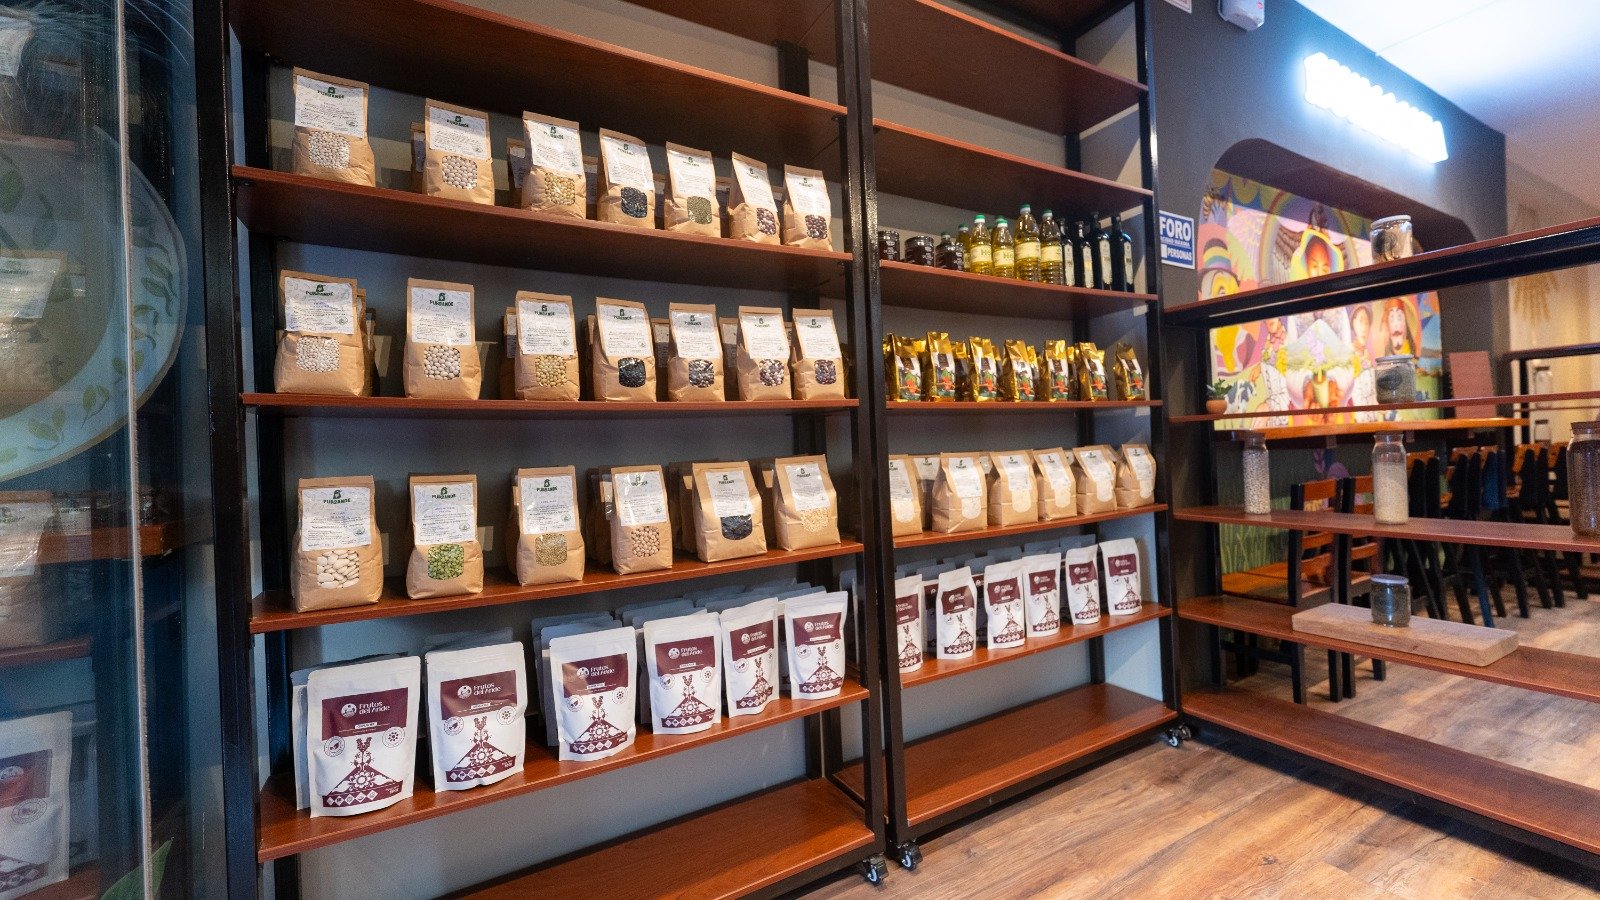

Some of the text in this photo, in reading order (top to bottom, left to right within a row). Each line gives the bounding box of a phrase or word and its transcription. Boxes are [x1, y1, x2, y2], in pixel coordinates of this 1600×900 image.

[1167, 247, 1192, 260] PERSONAS
[473, 682, 495, 691] Frutos
[359, 701, 383, 710] Frutos
[359, 704, 390, 715] del Ande
